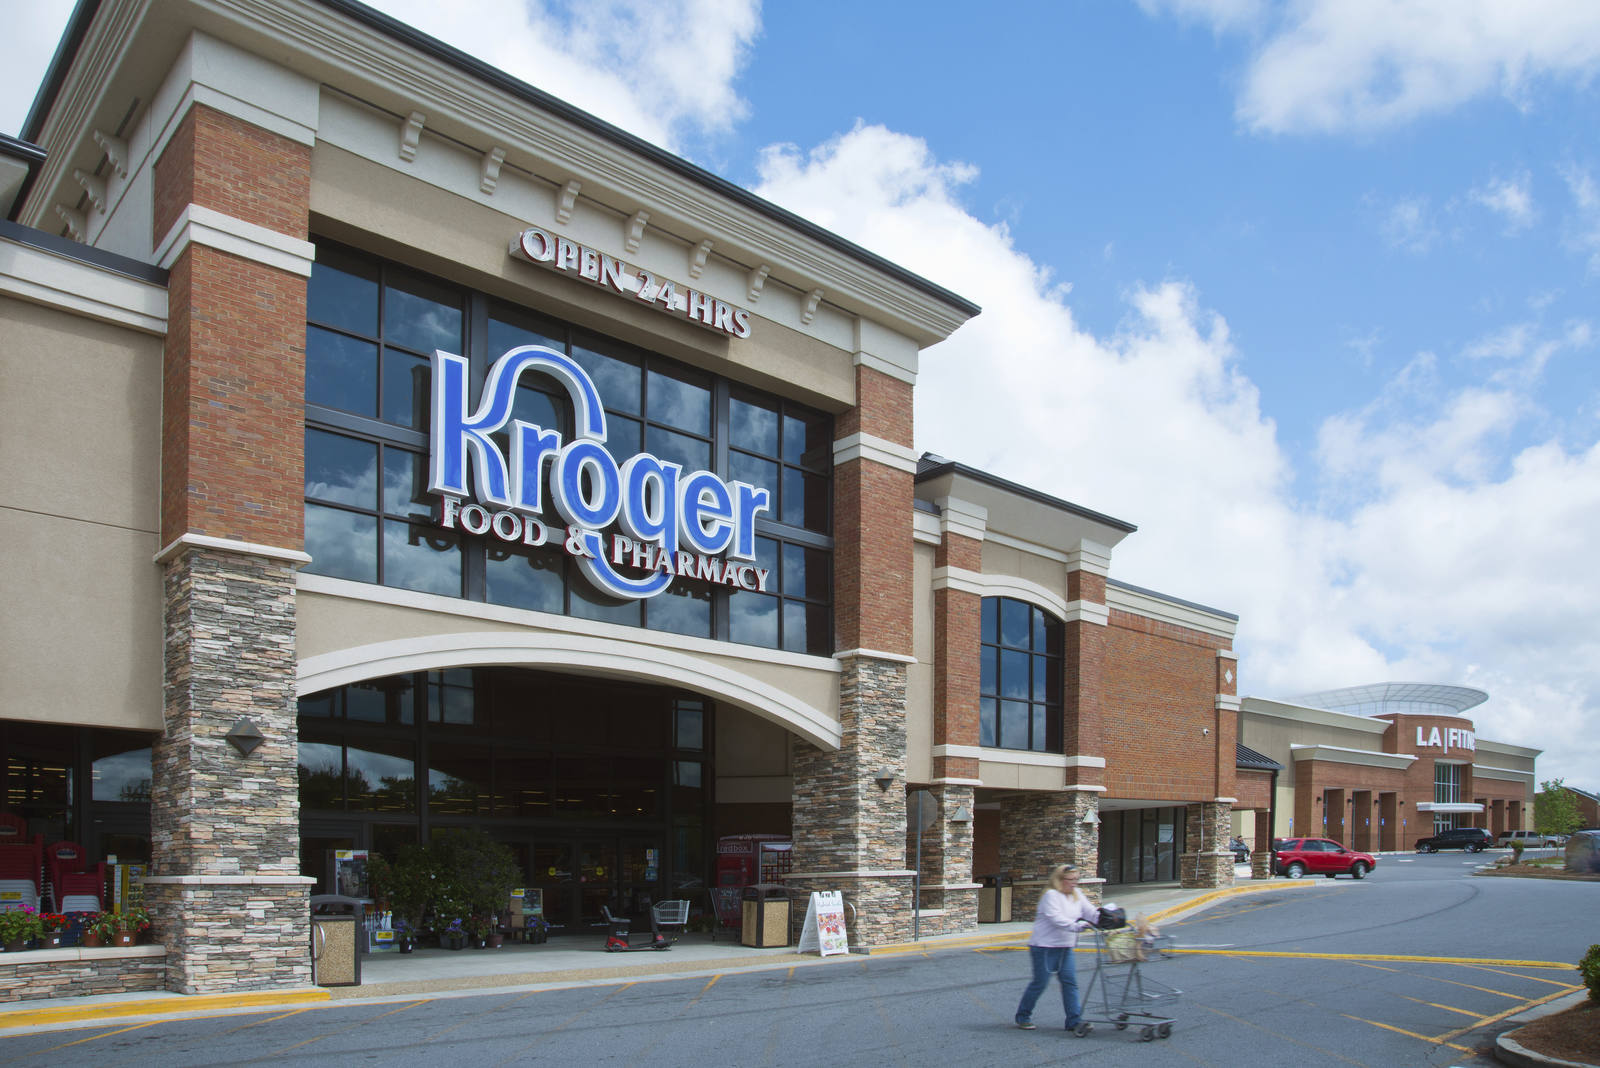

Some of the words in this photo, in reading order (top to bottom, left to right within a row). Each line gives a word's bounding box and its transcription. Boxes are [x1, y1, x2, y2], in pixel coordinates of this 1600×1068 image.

[520, 227, 625, 293] OPEN
[636, 270, 677, 311] 24
[687, 289, 751, 339] HRS
[428, 344, 770, 599] Kroger
[441, 495, 548, 546] FOOD
[563, 523, 598, 559] &
[611, 533, 769, 592] PHARMACY
[1416, 726, 1442, 747] LA
